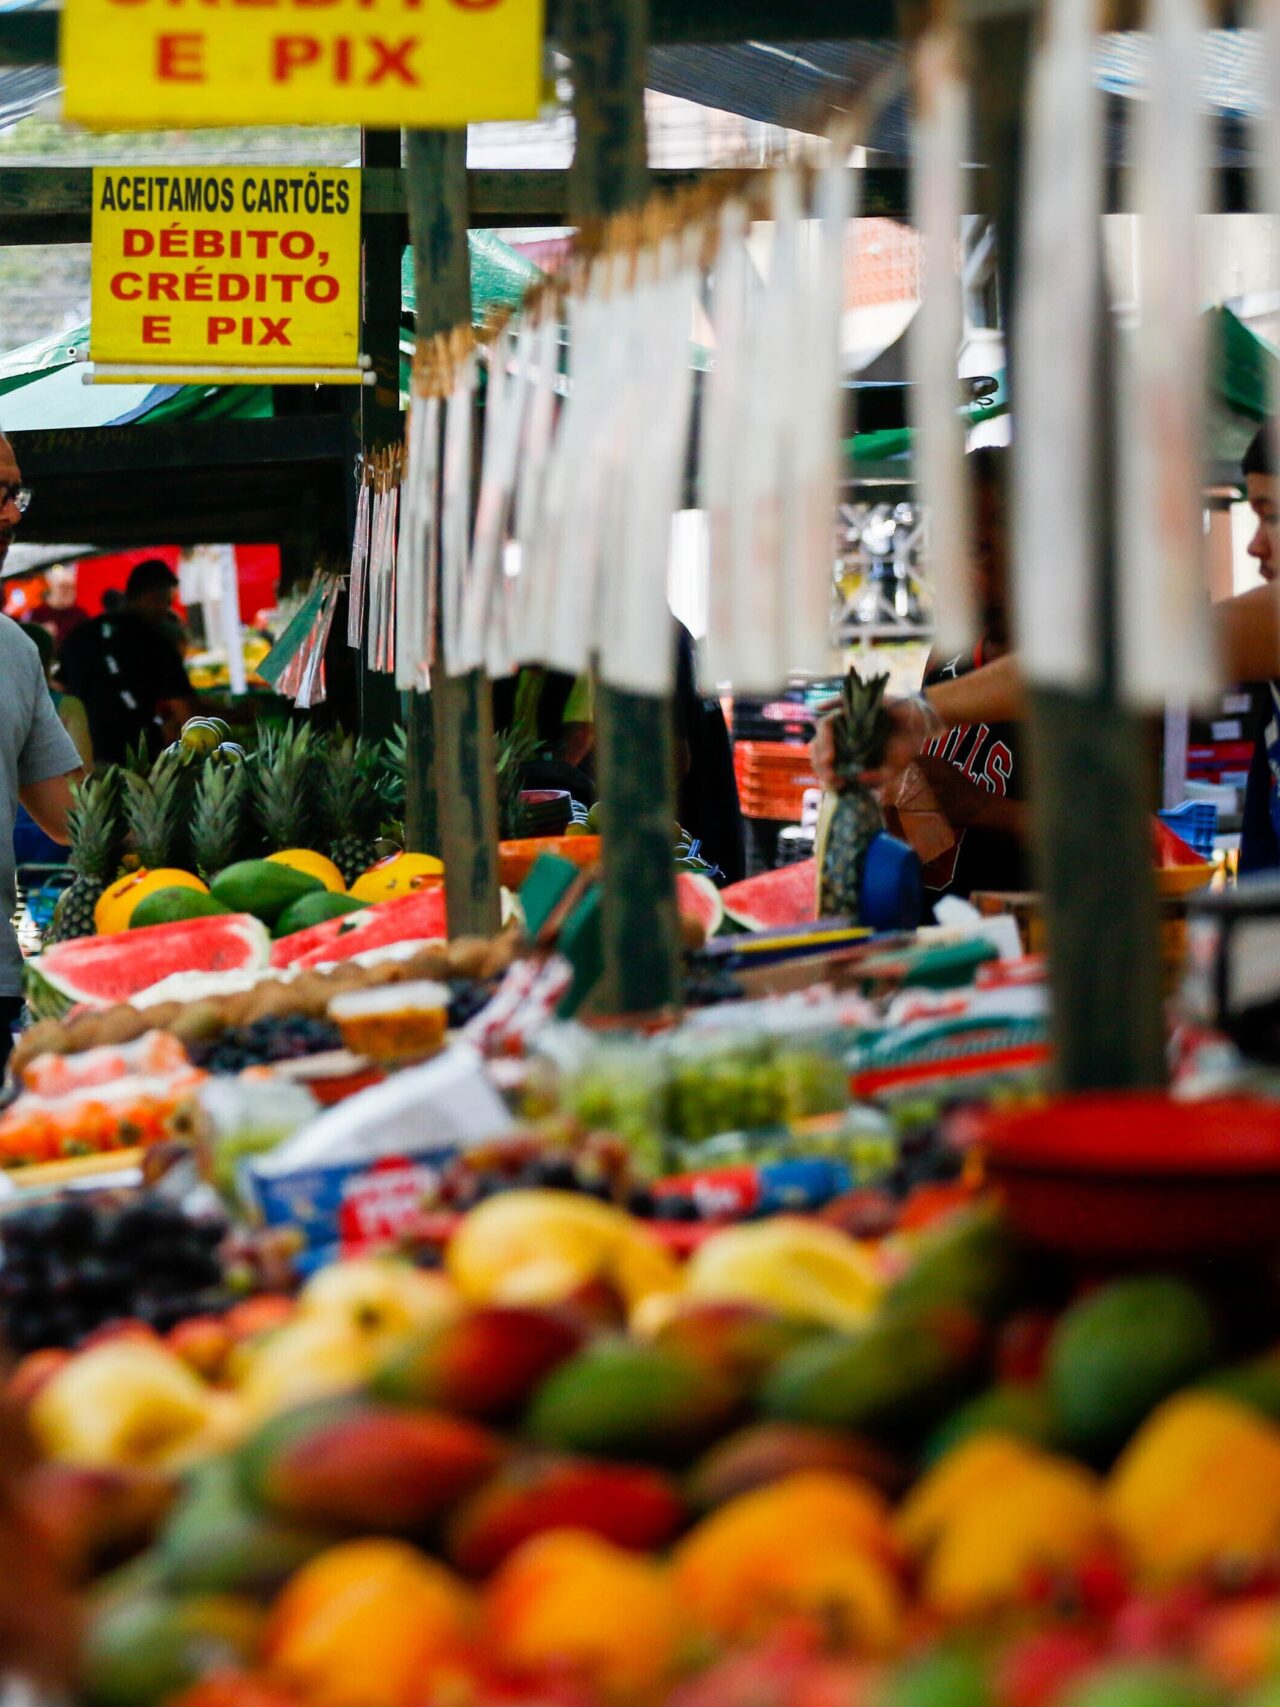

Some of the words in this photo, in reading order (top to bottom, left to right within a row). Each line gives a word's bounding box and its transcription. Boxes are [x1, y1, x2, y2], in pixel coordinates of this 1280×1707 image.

[155, 31, 206, 83] E
[271, 35, 421, 87] PIX
[100, 176, 234, 212] ACEITAMOS
[242, 171, 350, 214] CARTÕES
[122, 222, 330, 267] DÉBITO,
[110, 265, 340, 304] CRÉDITO
[142, 315, 171, 344] E
[207, 316, 293, 346] PIX
